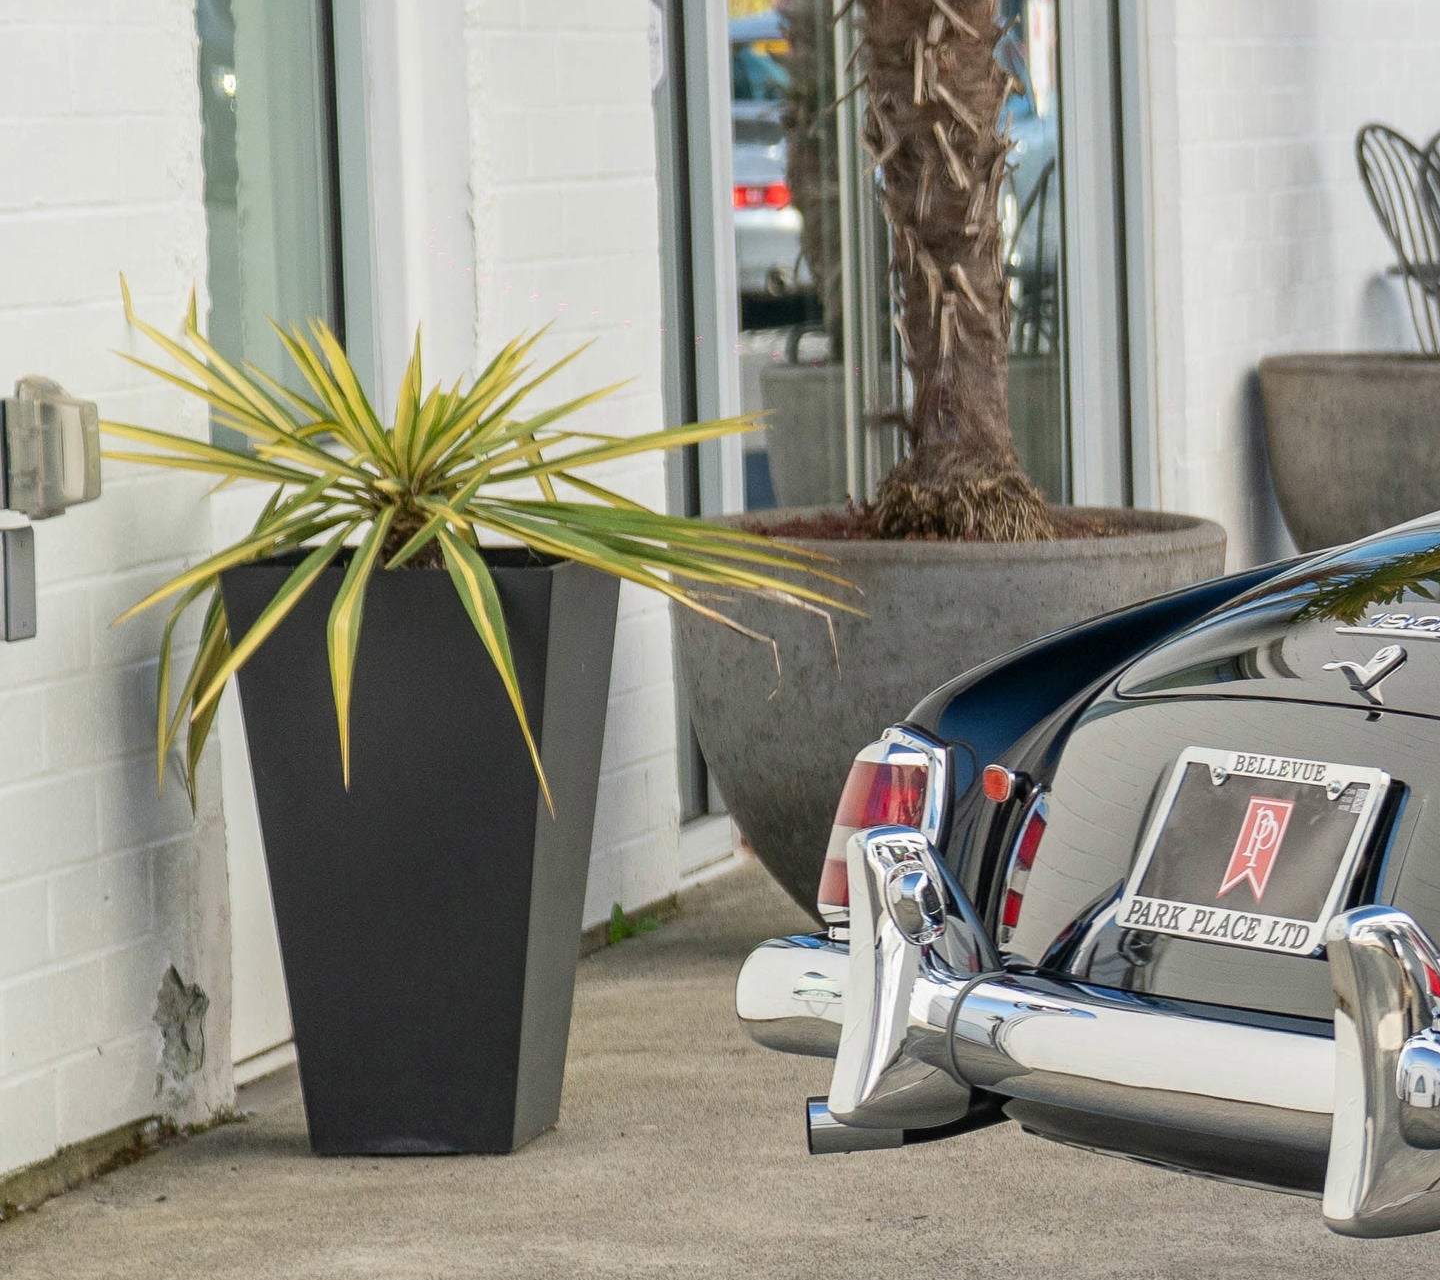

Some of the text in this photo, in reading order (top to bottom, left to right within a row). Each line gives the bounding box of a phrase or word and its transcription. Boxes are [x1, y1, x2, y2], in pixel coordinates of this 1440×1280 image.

[1233, 754, 1327, 782] BELLEVUE
[1124, 899, 1310, 950] PARK PLACE LTD
